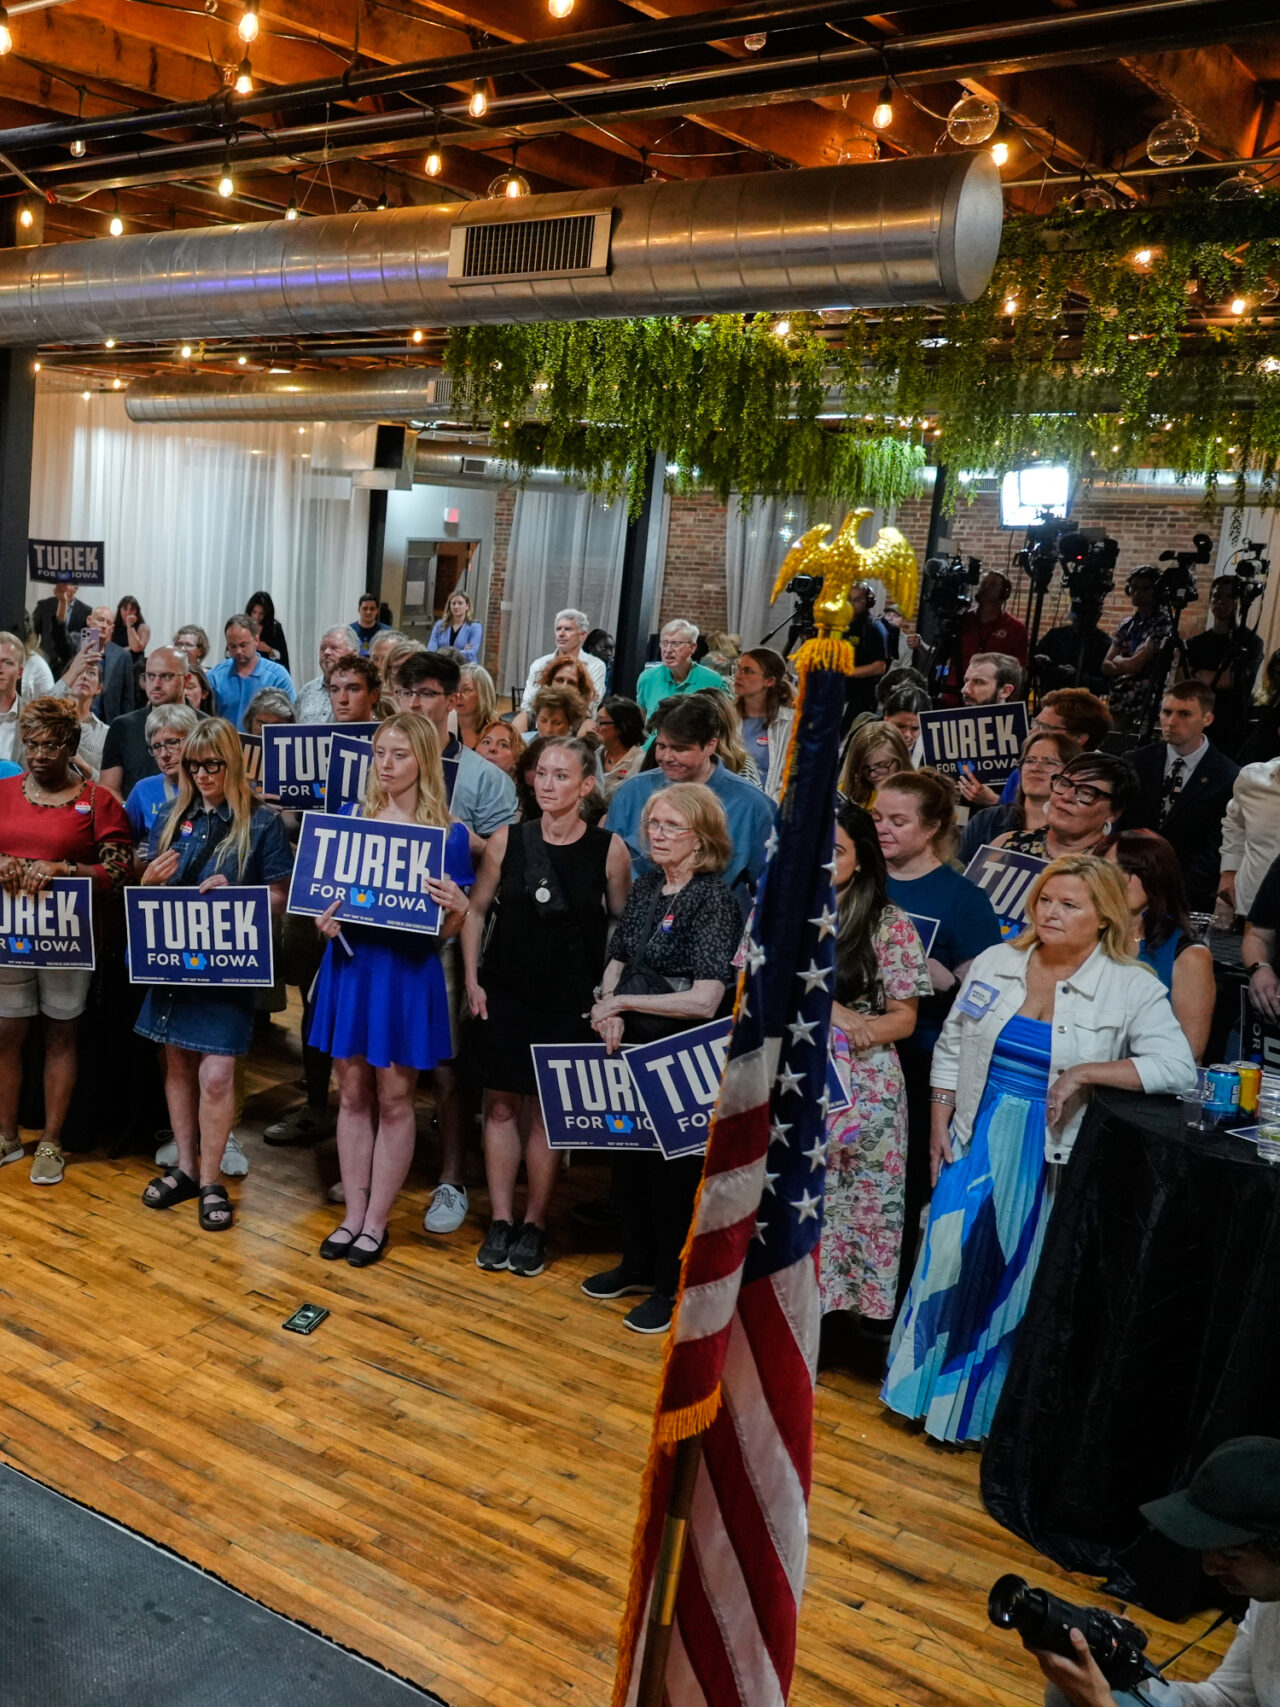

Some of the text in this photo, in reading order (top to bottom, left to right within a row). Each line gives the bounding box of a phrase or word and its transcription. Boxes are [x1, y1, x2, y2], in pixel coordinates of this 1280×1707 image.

[33, 544, 99, 571] TUREK
[37, 569, 98, 579] FOR IOWA
[927, 714, 1019, 761] TUREK
[273, 736, 348, 782] TUR
[936, 758, 1020, 773] FOR IOWA
[279, 785, 311, 796] FOR
[313, 827, 432, 894] TUREK
[309, 883, 427, 913] FOR IOWA
[137, 900, 259, 951] TUREK
[34, 940, 81, 952] IOWA
[147, 953, 259, 967] FOR IOWA
[547, 1058, 642, 1112] TUR
[565, 1115, 604, 1129] FOR
